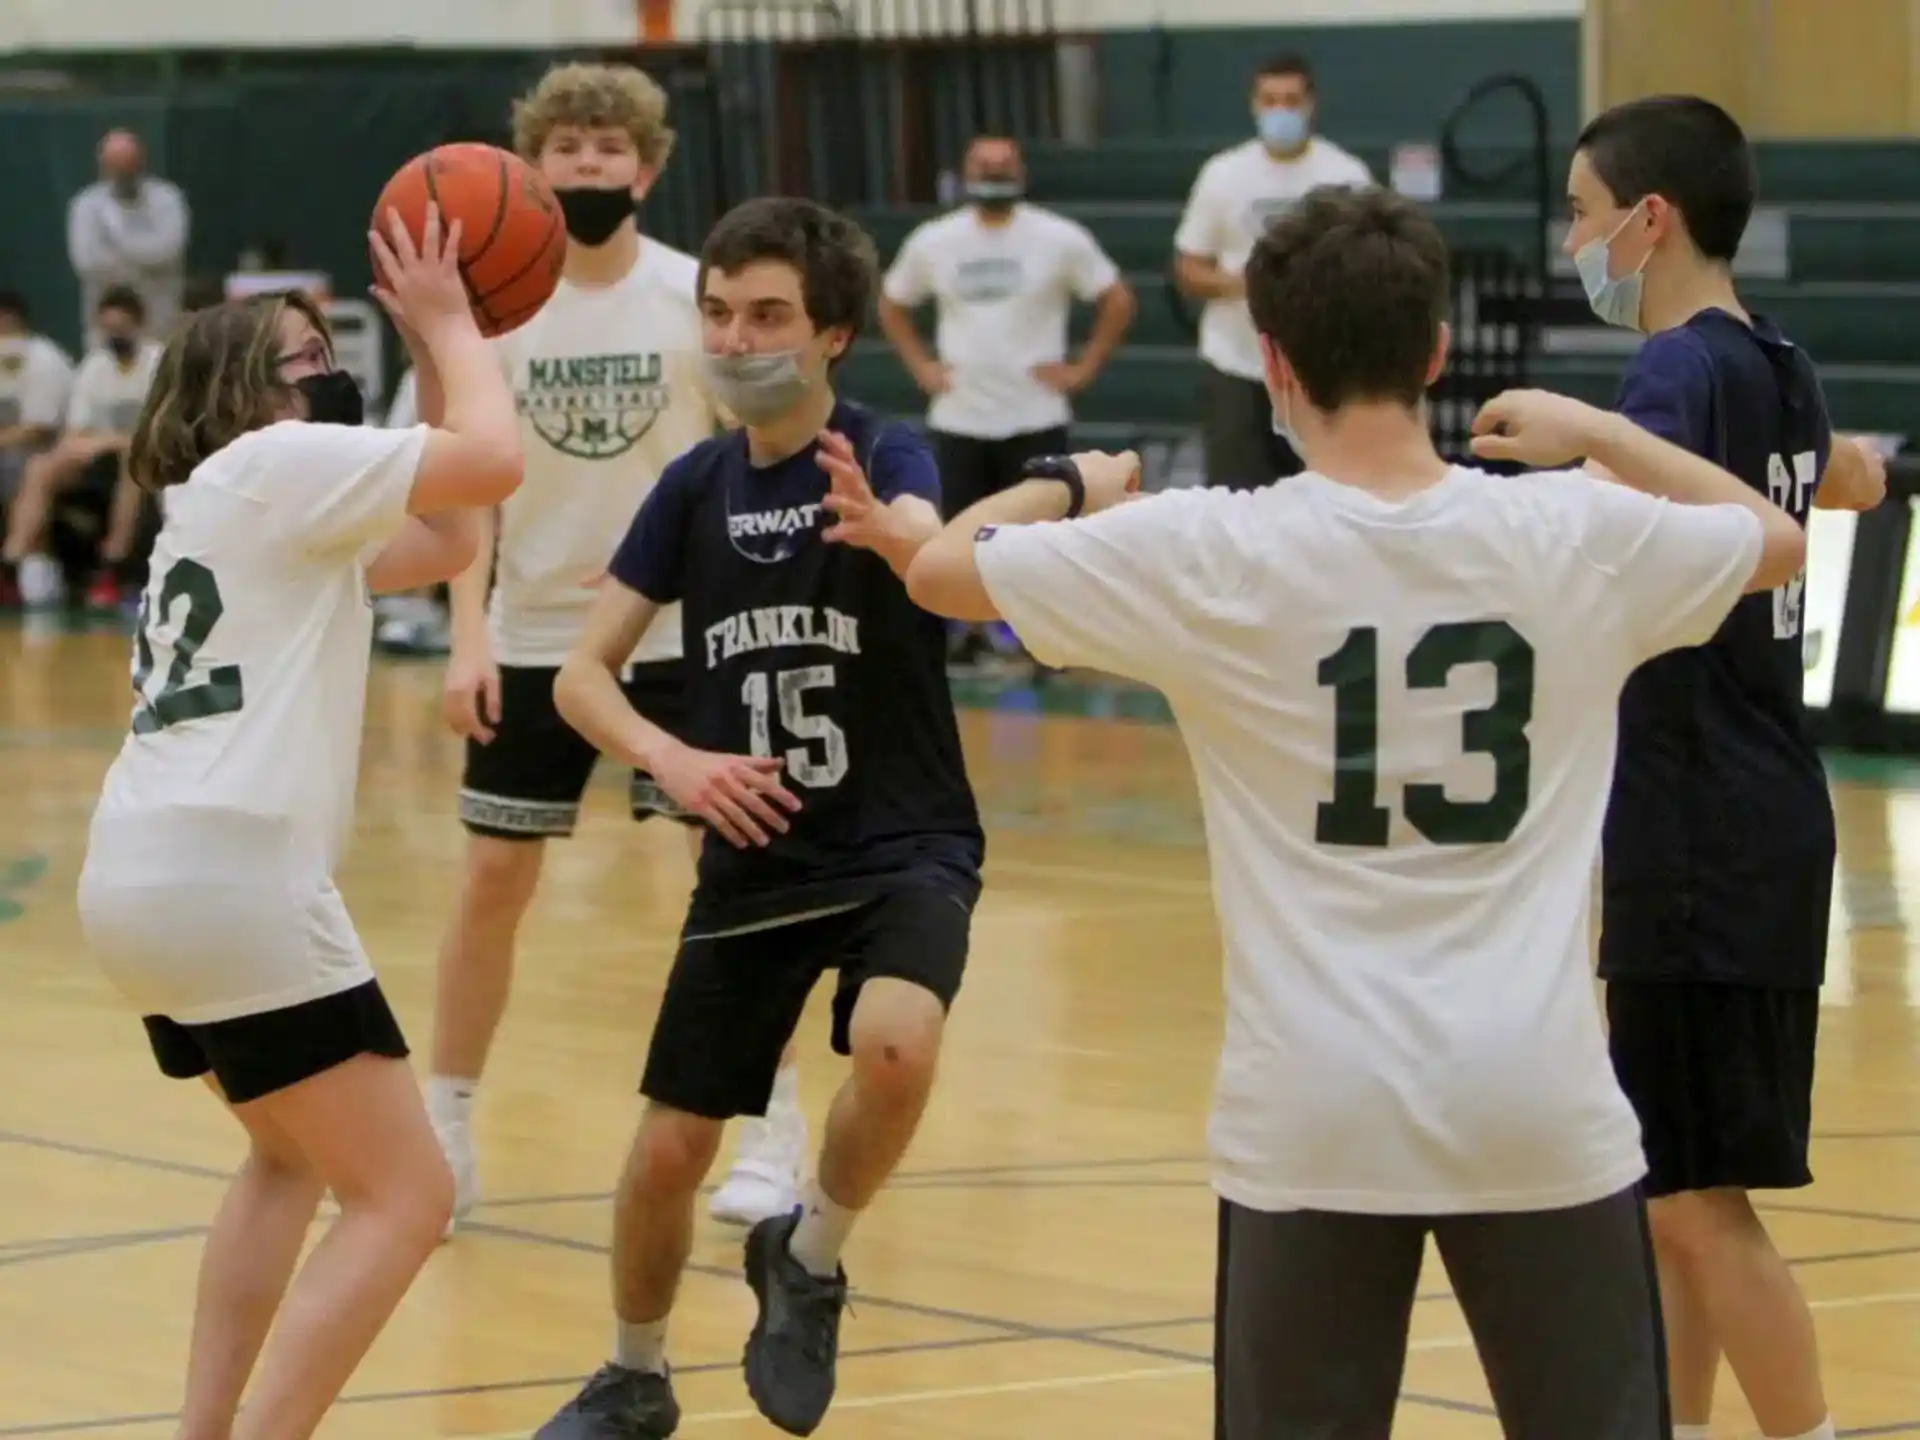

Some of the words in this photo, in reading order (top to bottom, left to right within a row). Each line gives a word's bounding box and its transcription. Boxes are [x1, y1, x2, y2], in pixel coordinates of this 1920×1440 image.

[528, 352, 661, 388] MANSFIELD
[515, 388, 669, 414] BASKETBALL
[583, 417, 607, 442] M
[704, 605, 861, 670] FRANKLIN
[741, 664, 849, 788] 15
[1315, 619, 1535, 848] 13
